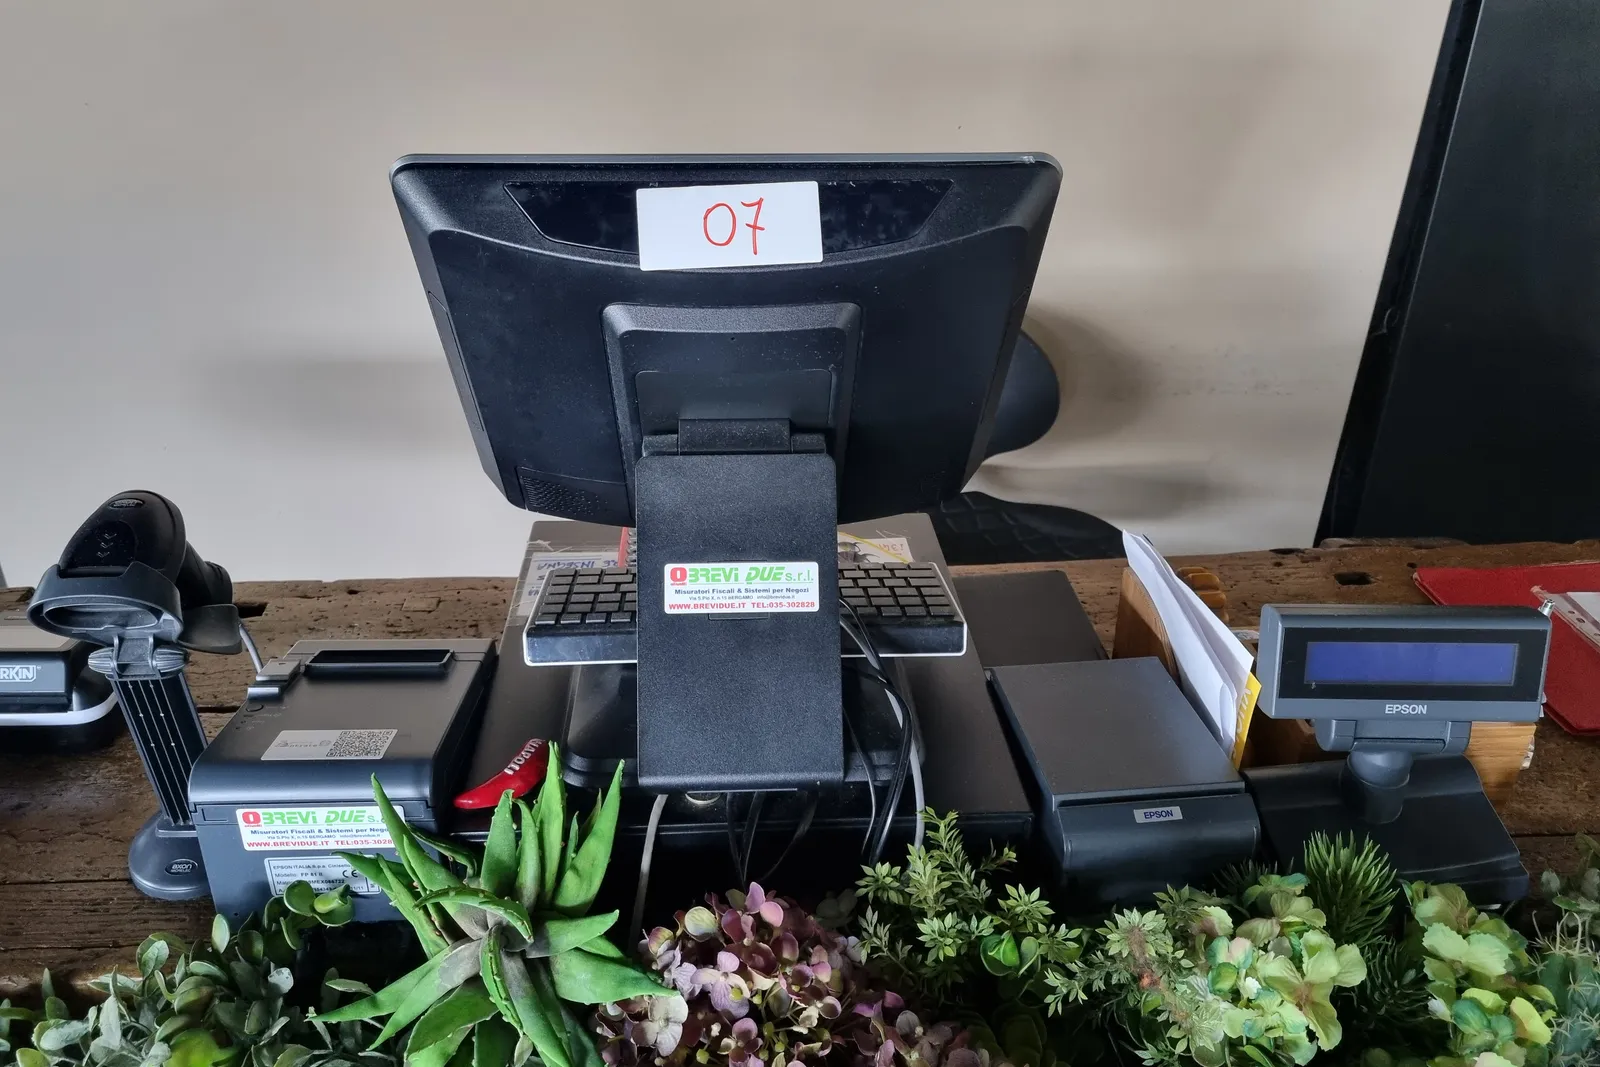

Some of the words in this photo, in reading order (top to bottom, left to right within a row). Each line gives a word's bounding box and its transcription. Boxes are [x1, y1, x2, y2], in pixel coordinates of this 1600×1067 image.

[703, 197, 766, 255] 07
[745, 566, 785, 585] DUE
[785, 569, 814, 582] s.r.l.
[786, 587, 809, 595] Negozi
[669, 602, 746, 610] WWW.BREVIDUE.IT
[751, 601, 815, 609] TEL:035-302828
[1385, 704, 1427, 715] EPSON
[325, 810, 366, 826] DUE
[1143, 810, 1174, 820] EPSON
[247, 840, 329, 848] WWW.BREVIDUE.IT
